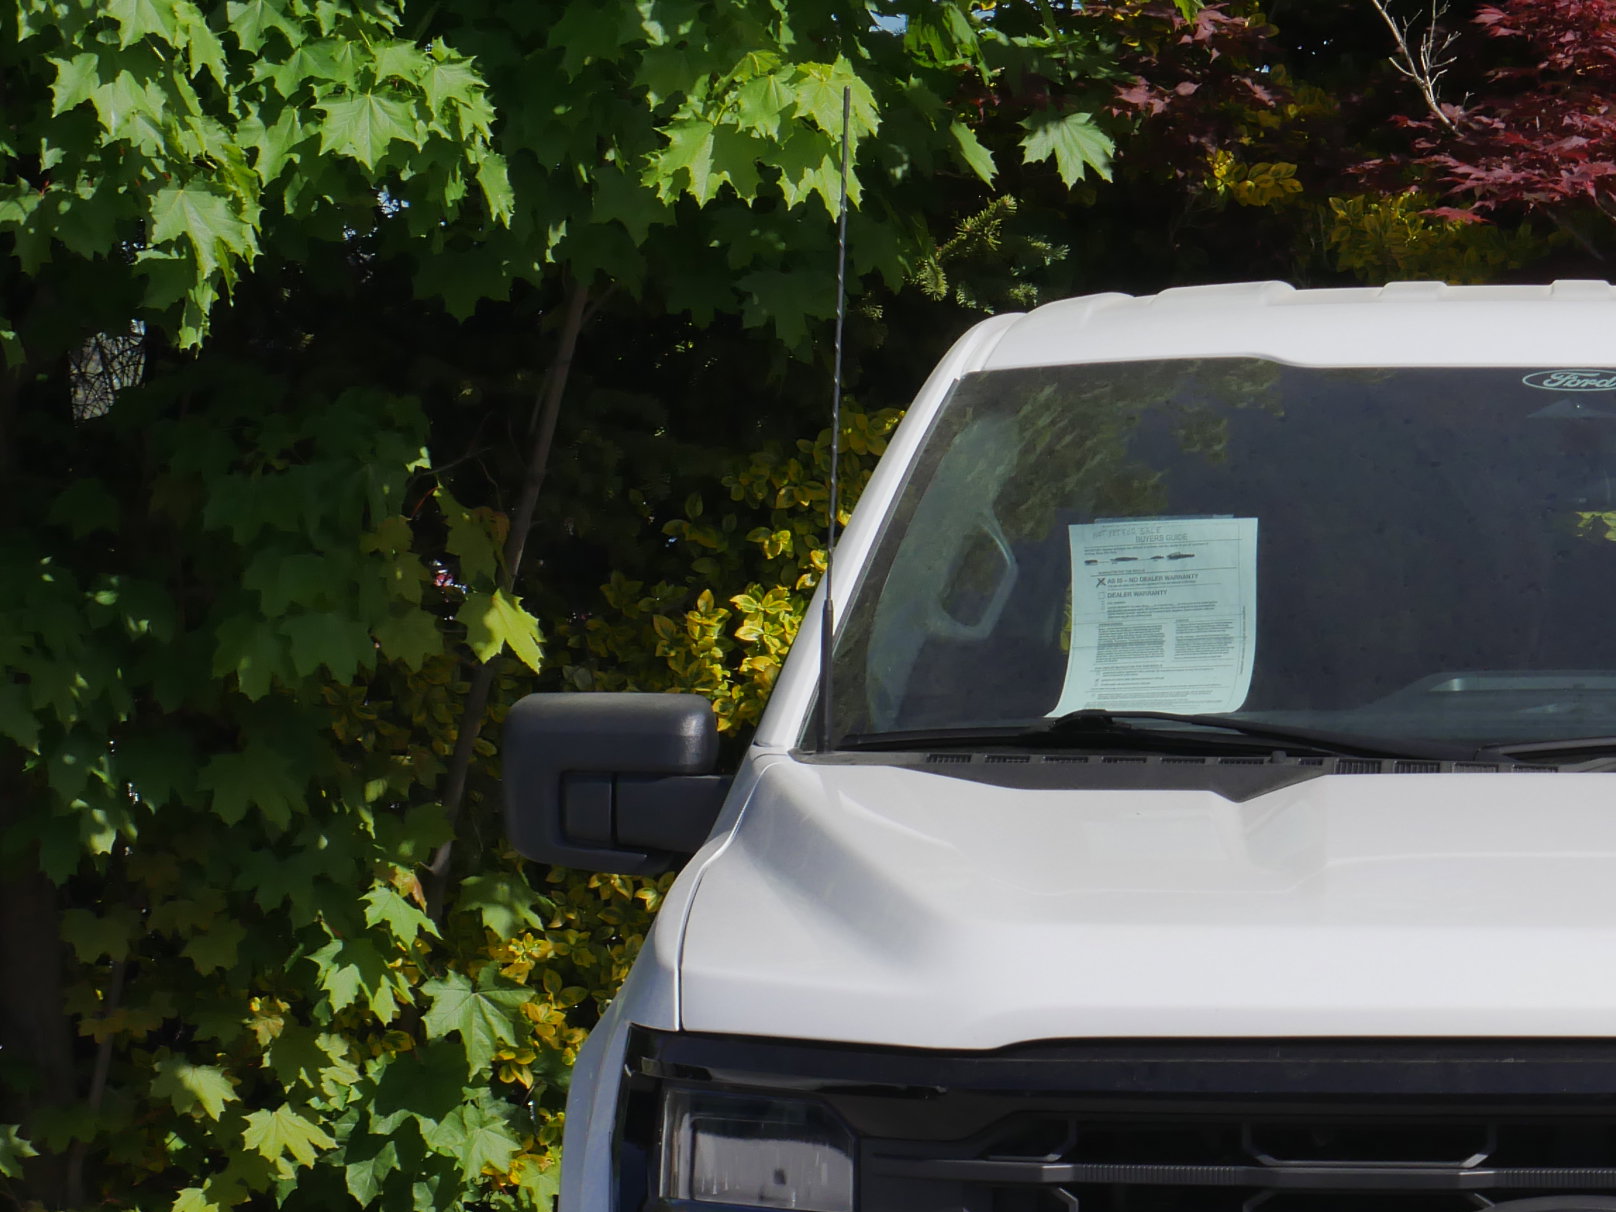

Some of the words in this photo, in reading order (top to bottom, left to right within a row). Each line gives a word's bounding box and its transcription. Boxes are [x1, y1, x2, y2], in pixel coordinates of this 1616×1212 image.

[1135, 534, 1165, 543] BUYERS
[1166, 533, 1188, 542] GUIDE
[1140, 575, 1163, 583] DEALER
[1164, 573, 1199, 581] WARRANTY
[1107, 591, 1132, 599] DEALER
[1134, 589, 1168, 598] WARRANTY
